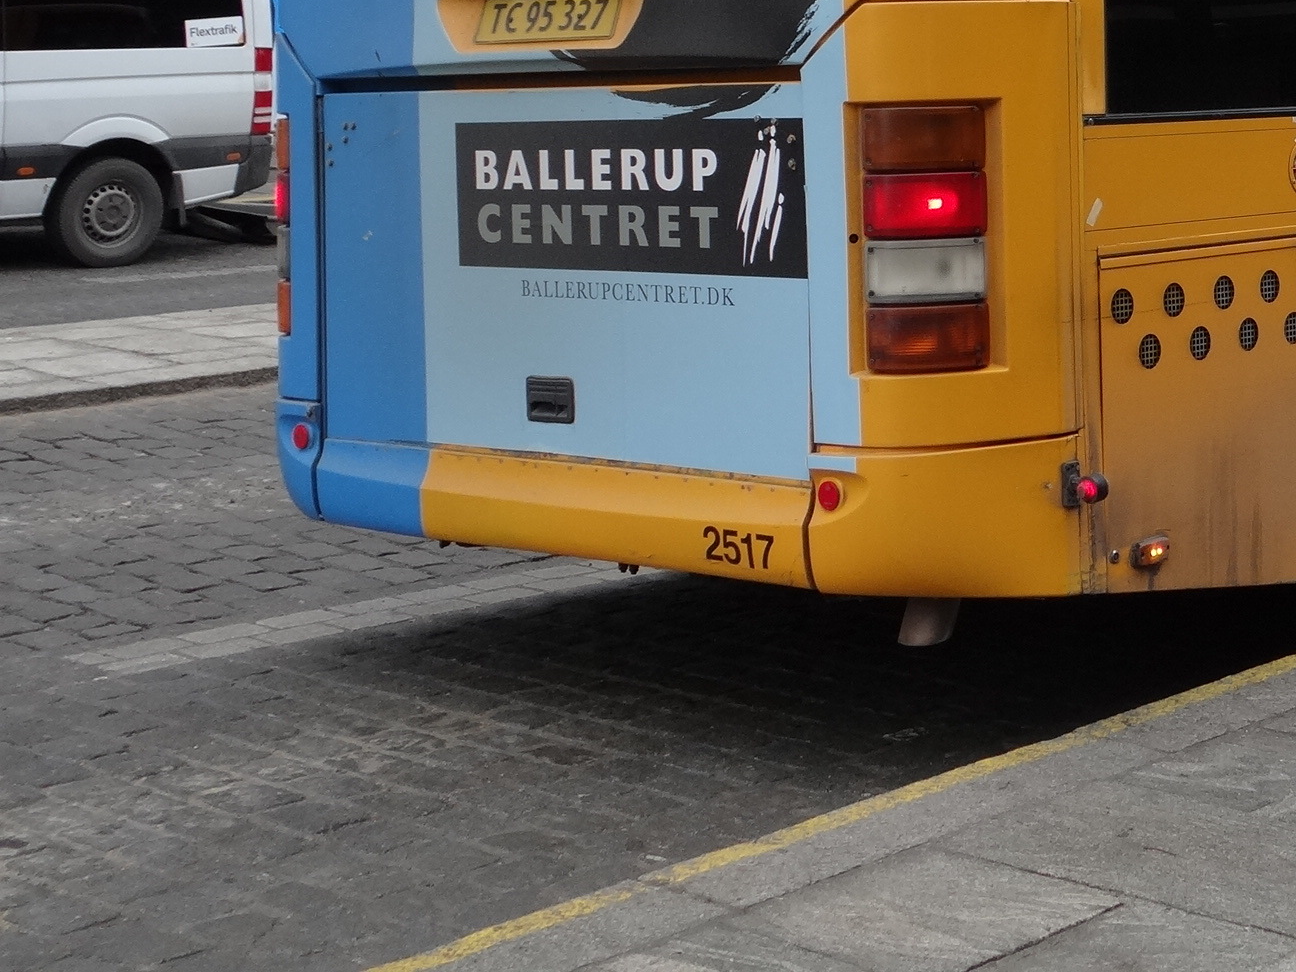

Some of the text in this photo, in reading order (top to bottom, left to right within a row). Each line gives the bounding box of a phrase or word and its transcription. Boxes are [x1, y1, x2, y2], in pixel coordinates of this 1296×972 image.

[189, 24, 238, 38] Flextrafik
[526, 0, 556, 32] 95
[474, 148, 719, 192] BALLERUP
[477, 203, 720, 249] CENTRET
[520, 278, 735, 308] BALLERUPCENTRET.DK
[702, 525, 775, 570] 2517
